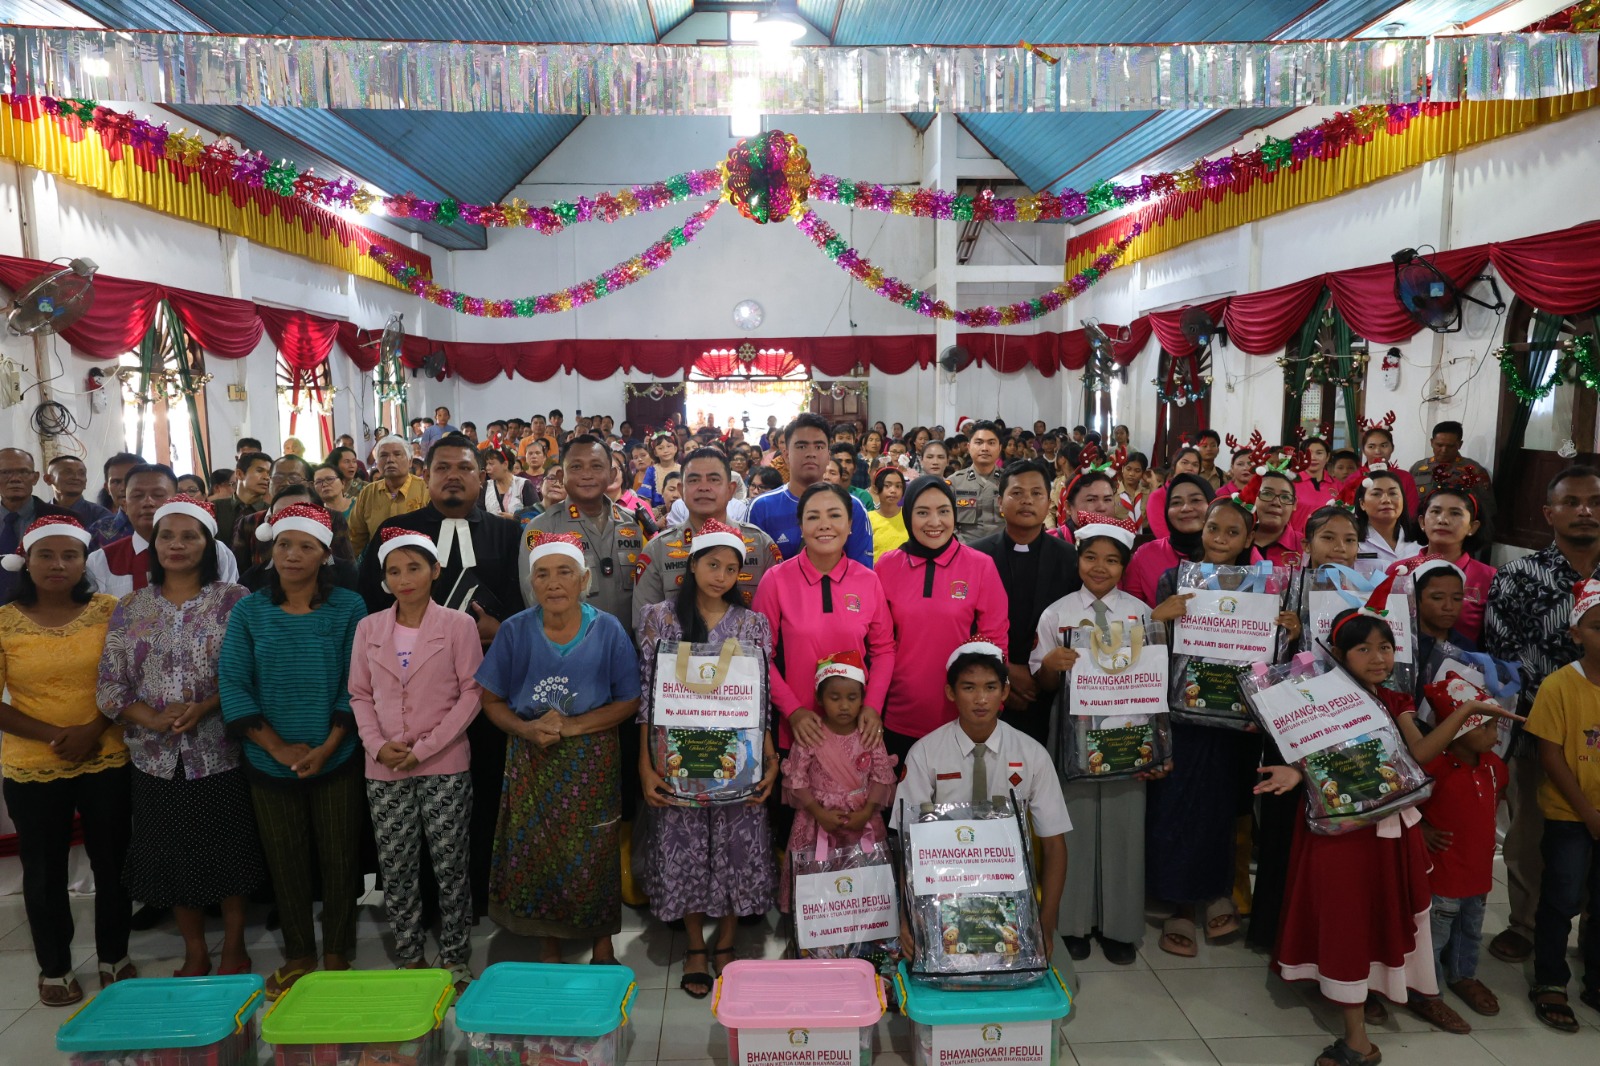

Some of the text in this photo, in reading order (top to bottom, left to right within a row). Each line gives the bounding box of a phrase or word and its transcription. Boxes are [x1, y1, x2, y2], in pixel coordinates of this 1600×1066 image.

[618, 539, 641, 548] POLRI
[1180, 615, 1271, 632] BHAYANGKARI PEDULI
[1183, 638, 1191, 646] Ny.
[1193, 640, 1216, 648] JULIATI
[1218, 642, 1234, 650] SIGIT
[1077, 674, 1133, 685] BHAYANGKARI
[724, 685, 753, 695] PEDULI
[1328, 692, 1361, 710] PEDULI
[665, 708, 674, 716] Ny.
[1279, 722, 1301, 735] BANTUAN
[1300, 714, 1318, 725] KETUA
[1330, 700, 1365, 718] BHAYANGKARI
[1299, 730, 1324, 745] JULIATI
[1323, 724, 1341, 735] SIGIT
[919, 847, 1015, 859] BHAYANGKARI PEDULI
[938, 875, 962, 883] JULIATI
[981, 873, 1015, 881] PRABOWO
[802, 894, 891, 915] BHAYANGKARI PEDULI
[858, 905, 891, 914] BHAYANGKARI
[819, 928, 842, 936] JULIATI
[843, 925, 859, 933] SIGIT
[860, 921, 889, 930] PRABOWO
[747, 1050, 852, 1063] BHAYANGKARI PEDULI
[940, 1045, 1043, 1060] BHAYANGKARI PEDULI
